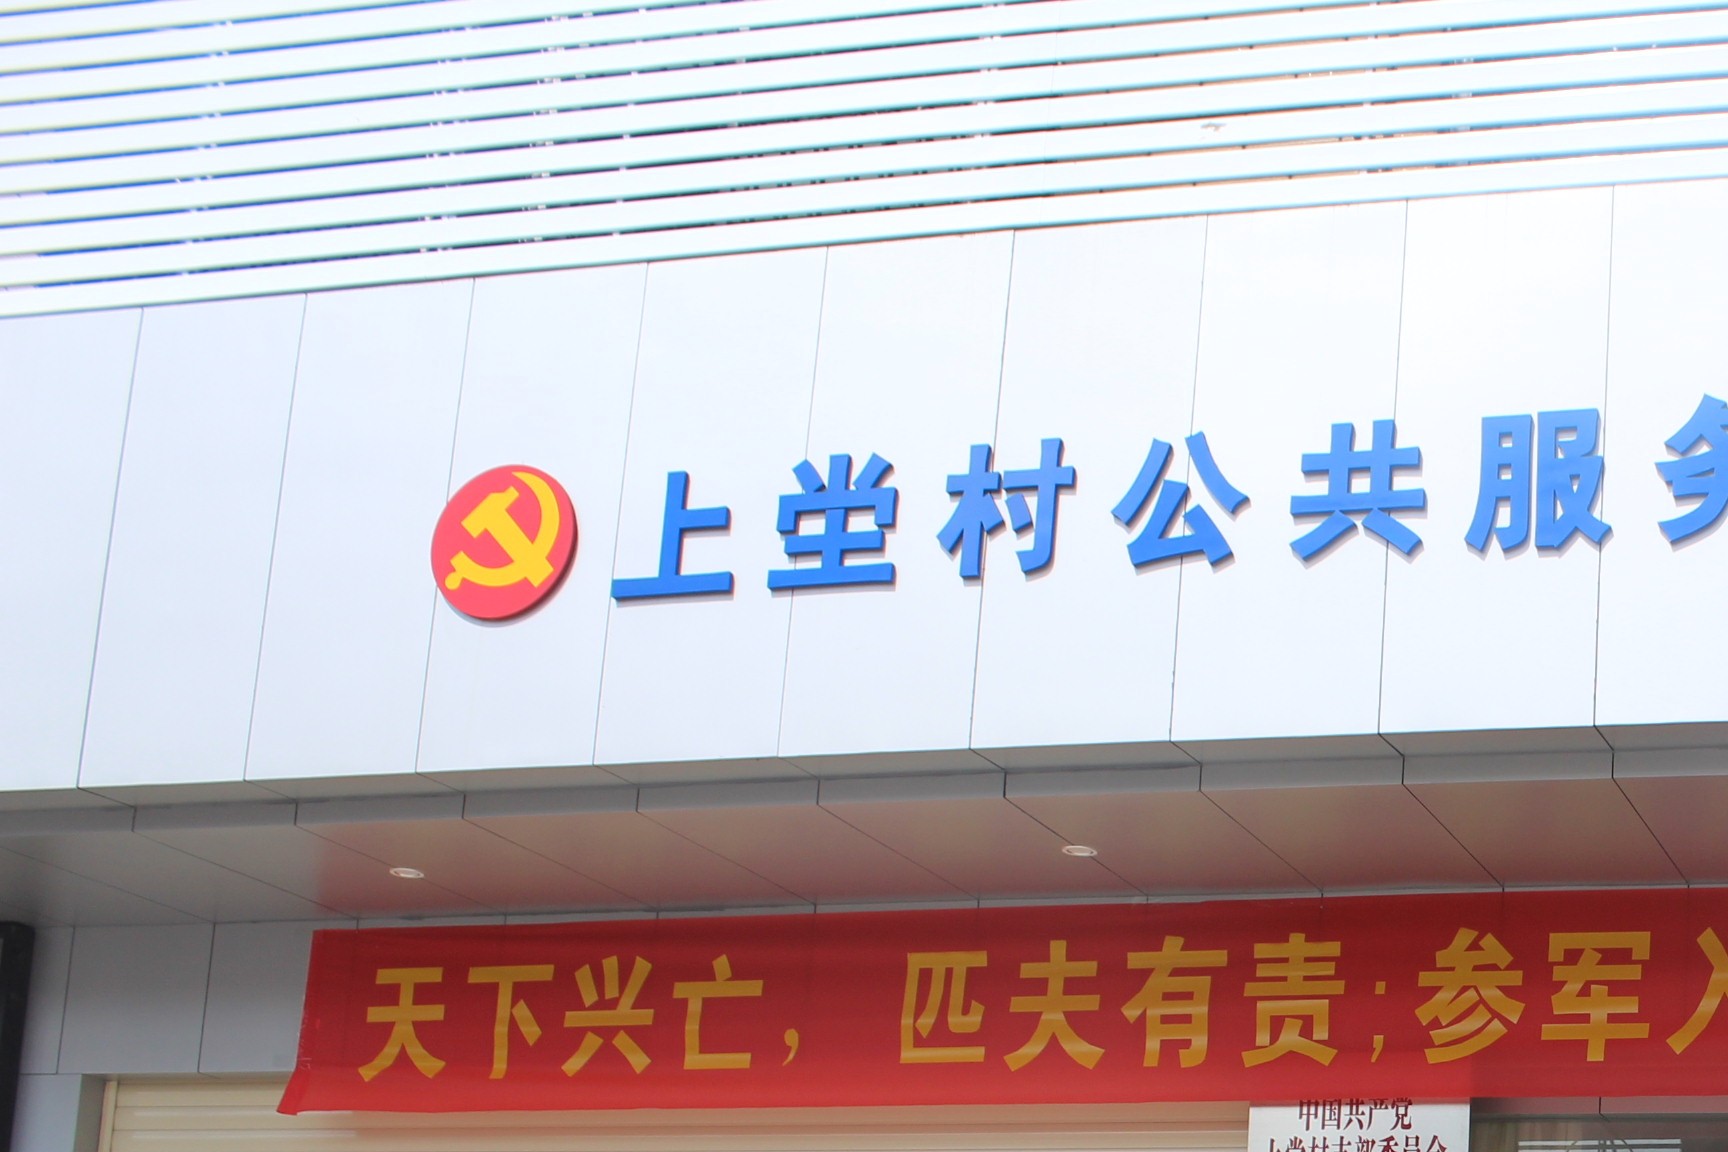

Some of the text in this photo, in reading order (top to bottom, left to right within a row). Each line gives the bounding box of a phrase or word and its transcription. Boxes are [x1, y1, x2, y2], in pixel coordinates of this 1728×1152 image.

[1297, 1099, 1413, 1132] 中国共产党
